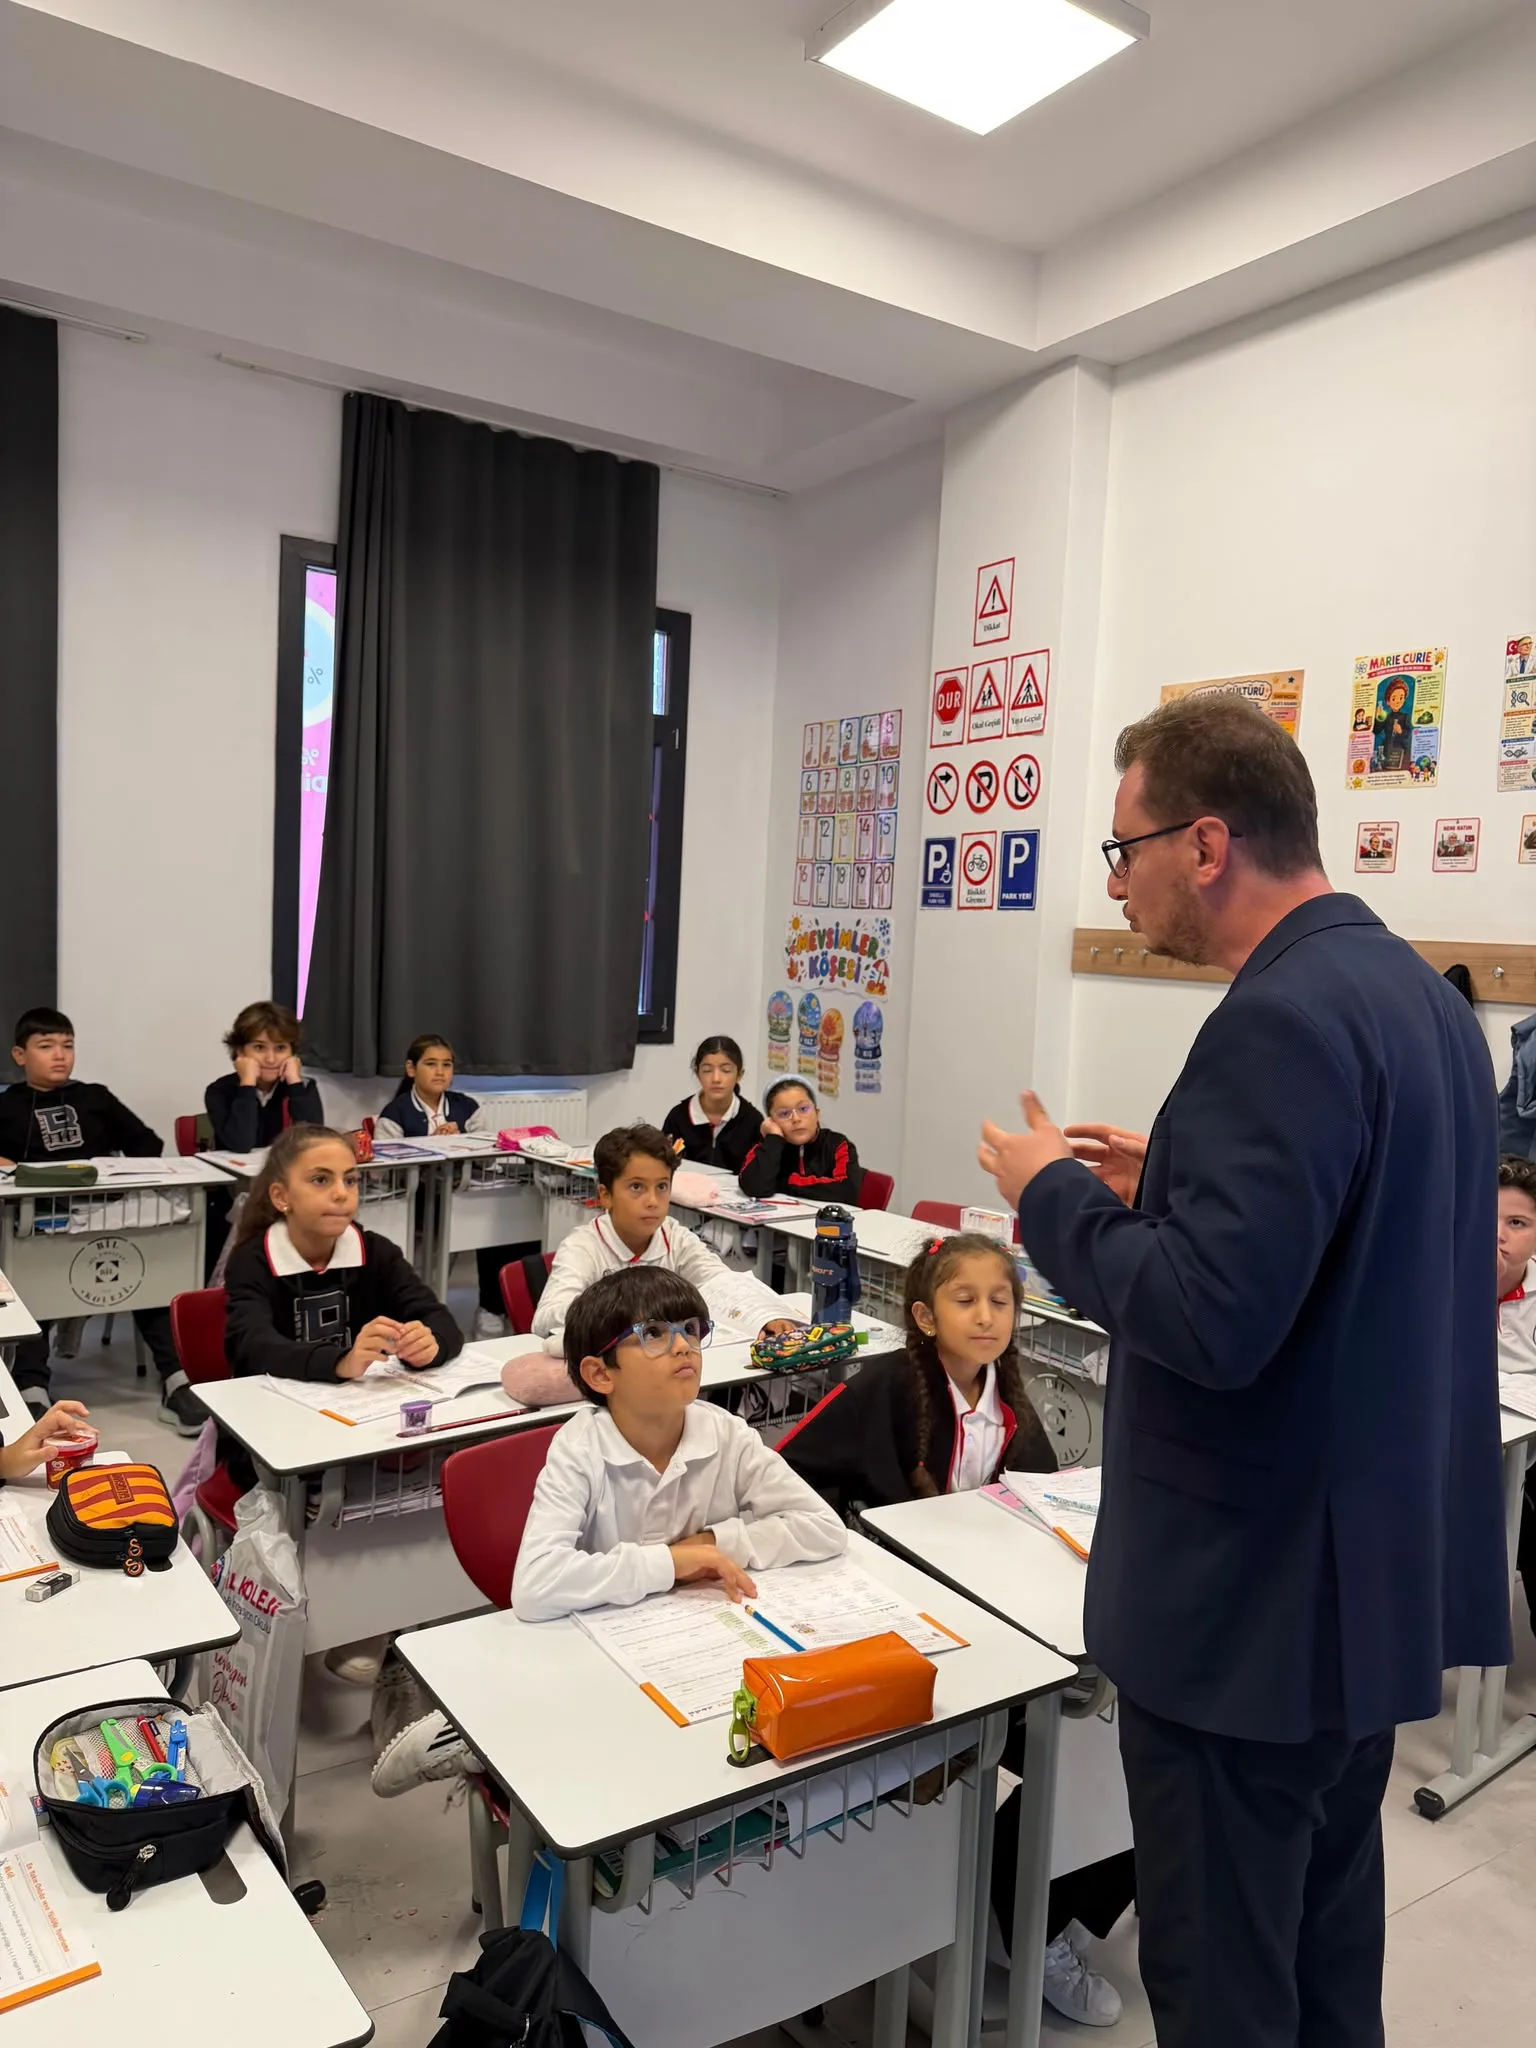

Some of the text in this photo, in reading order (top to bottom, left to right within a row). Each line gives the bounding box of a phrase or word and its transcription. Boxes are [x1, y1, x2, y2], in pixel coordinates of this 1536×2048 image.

[1369, 651, 1432, 670] MARIE CURIE
[937, 691, 961, 710] DUR
[845, 722, 853, 740] 3
[864, 718, 873, 734] 4
[886, 714, 895, 733] 5
[809, 726, 814, 742] 1
[826, 725, 835, 741] 2
[805, 774, 813, 791] 6
[823, 772, 831, 789] 7
[844, 771, 851, 788] 8
[862, 769, 870, 787] 9
[881, 766, 894, 785] 10
[820, 820, 830, 837] 12
[859, 818, 870, 836] 14
[879, 816, 891, 835] 15
[928, 844, 947, 883] P
[1008, 837, 1030, 878] P
[816, 866, 826, 883] 17
[836, 867, 845, 884] 18
[856, 866, 866, 884] 19
[875, 866, 890, 884] 20
[1002, 891, 1032, 900] PARK YERİ
[796, 921, 879, 960] MEVSİMLER
[809, 951, 862, 983] KÖŞESİ
